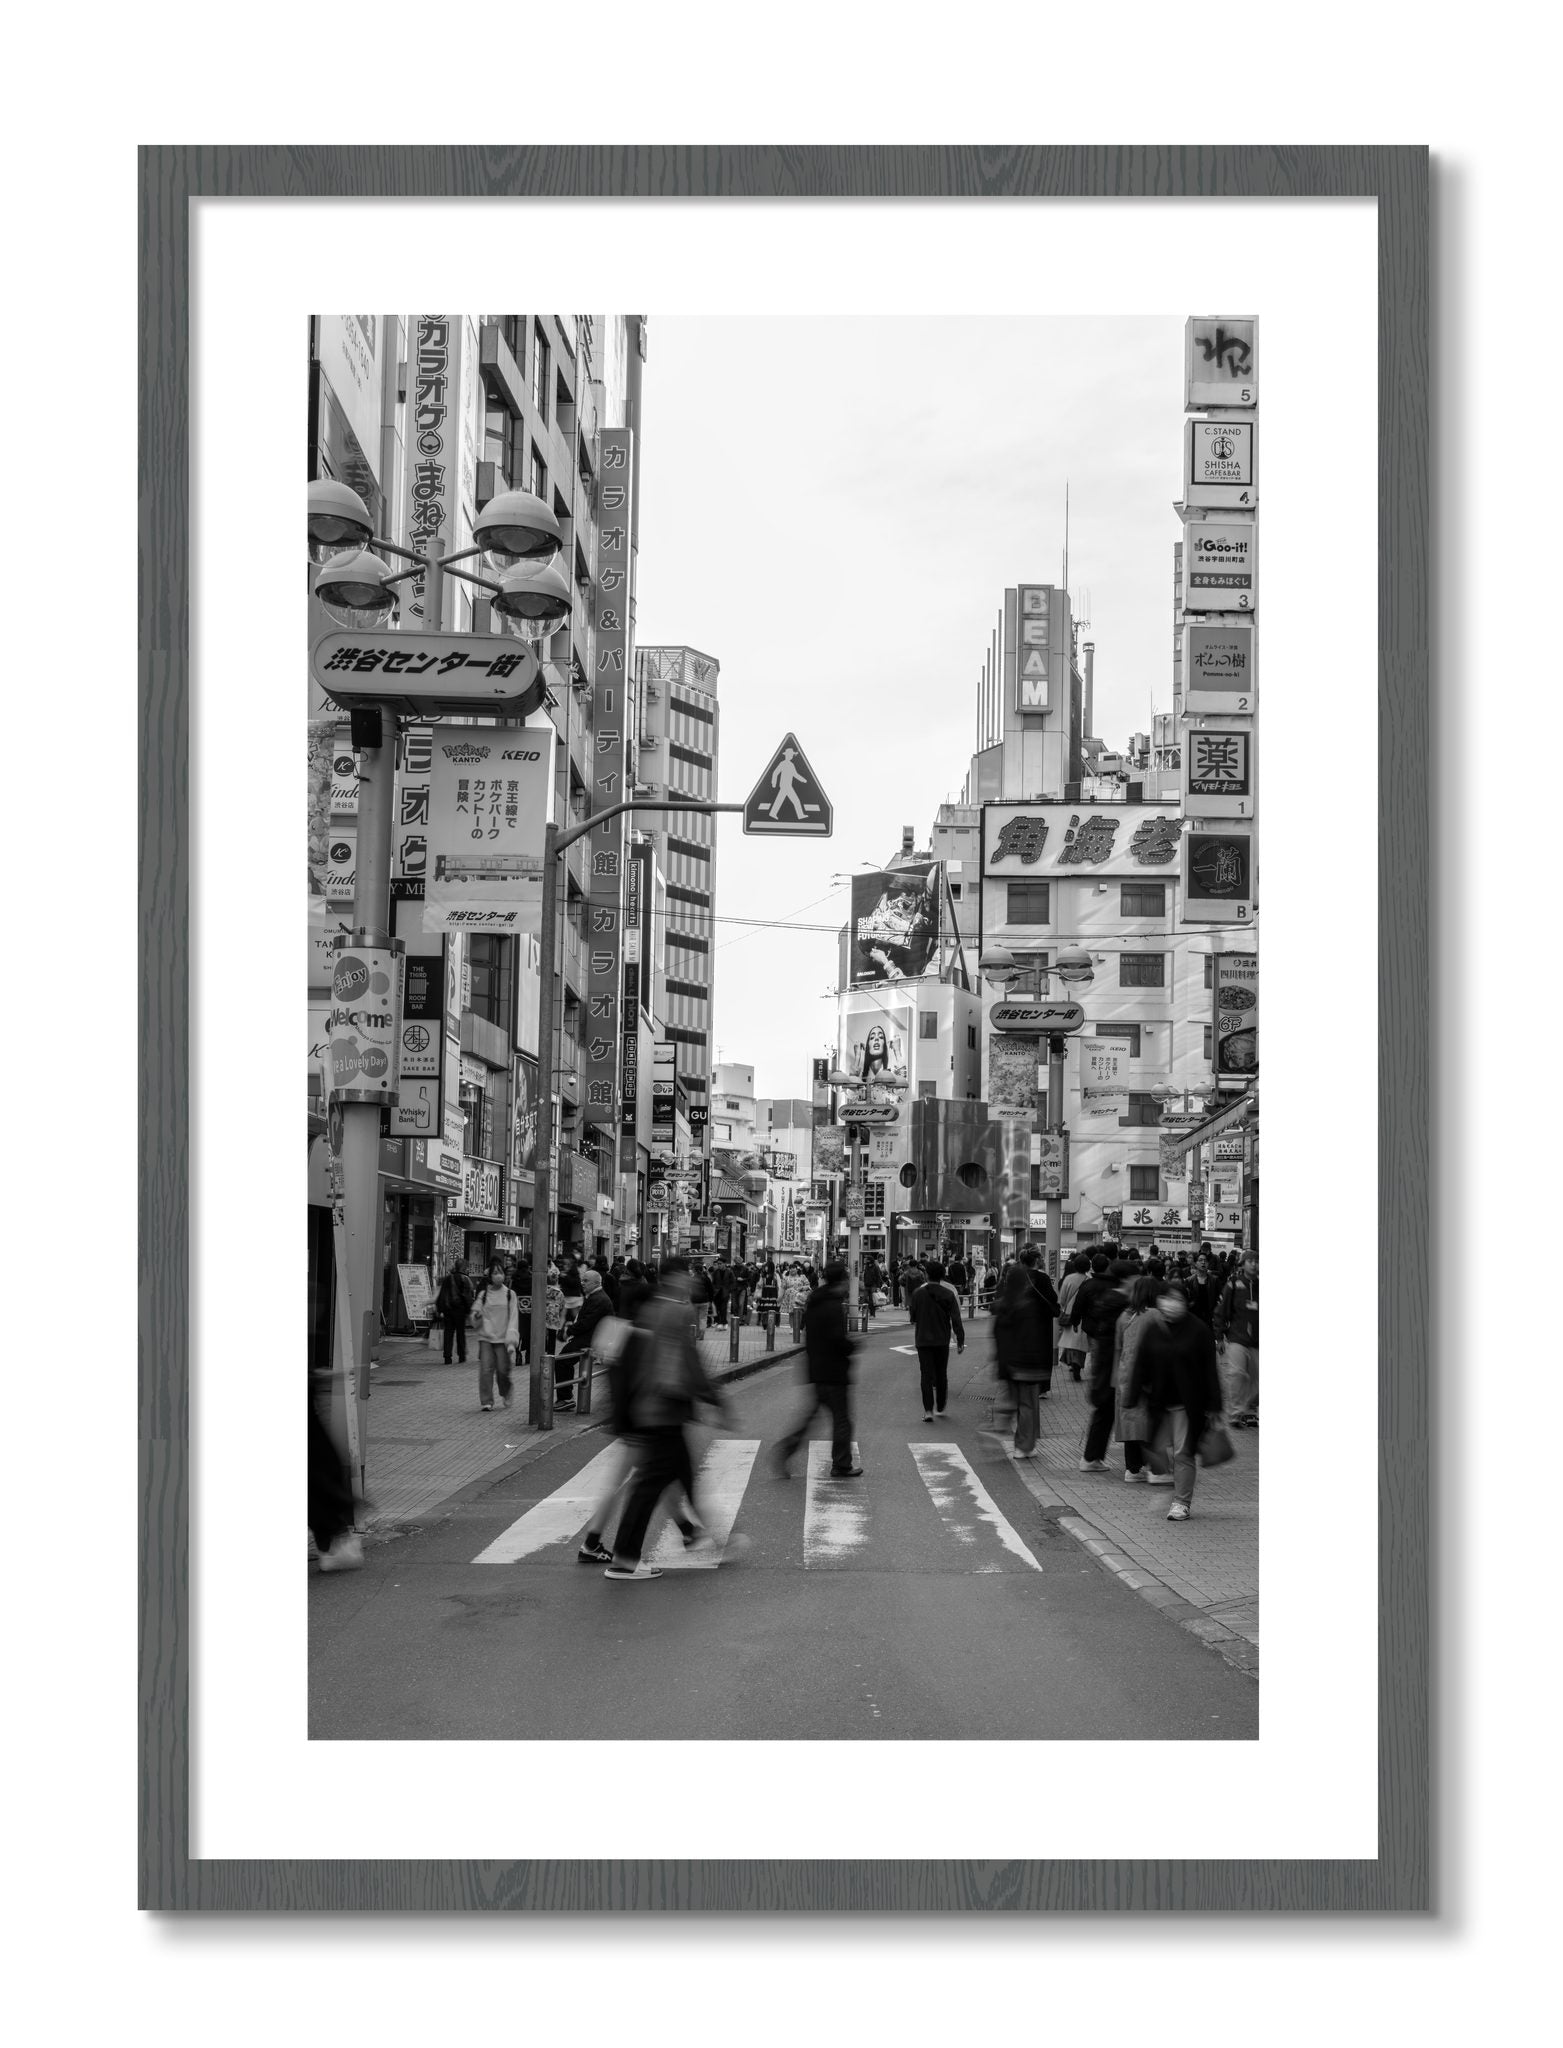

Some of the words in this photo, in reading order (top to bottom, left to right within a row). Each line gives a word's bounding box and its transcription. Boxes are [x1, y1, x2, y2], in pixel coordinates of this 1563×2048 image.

[415, 321, 449, 432] カラオケ
[1241, 389, 1251, 402] 5
[1204, 427, 1242, 436] C.STAND
[1204, 460, 1241, 470] SHISHA
[1239, 491, 1250, 505] 4
[1203, 539, 1248, 553] Goo-it!
[1193, 576, 1249, 586] 全身もみほぐし
[1238, 594, 1249, 608] 3
[1021, 589, 1049, 706] BEAM
[323, 647, 526, 678] 渋谷センター街
[1238, 697, 1249, 710] 2
[501, 750, 541, 761] KEIO
[1196, 736, 1239, 779] 薬
[456, 779, 470, 814] 冒険へ
[471, 779, 486, 840] カントーの
[505, 779, 519, 829] 京王線で
[1237, 801, 1245, 815] 1
[990, 815, 1183, 865] 角海老
[629, 863, 638, 892] kimono
[445, 911, 518, 922] 渋谷センター街
[1236, 906, 1247, 918] B
[334, 967, 368, 996] Enjoy
[587, 909, 618, 1107] カラオケ館
[995, 1008, 1079, 1020] 渋谷センター街
[331, 1007, 393, 1029] Welcome
[1219, 1016, 1243, 1032] 6F
[344, 1055, 369, 1071] Lovely
[370, 1055, 388, 1068] Day!
[399, 1108, 427, 1118] Whisky
[690, 1110, 708, 1121] GU
[840, 1108, 892, 1117] 渋谷センター街
[399, 1116, 415, 1124] Bank
[1133, 1208, 1182, 1226] 兆楽
